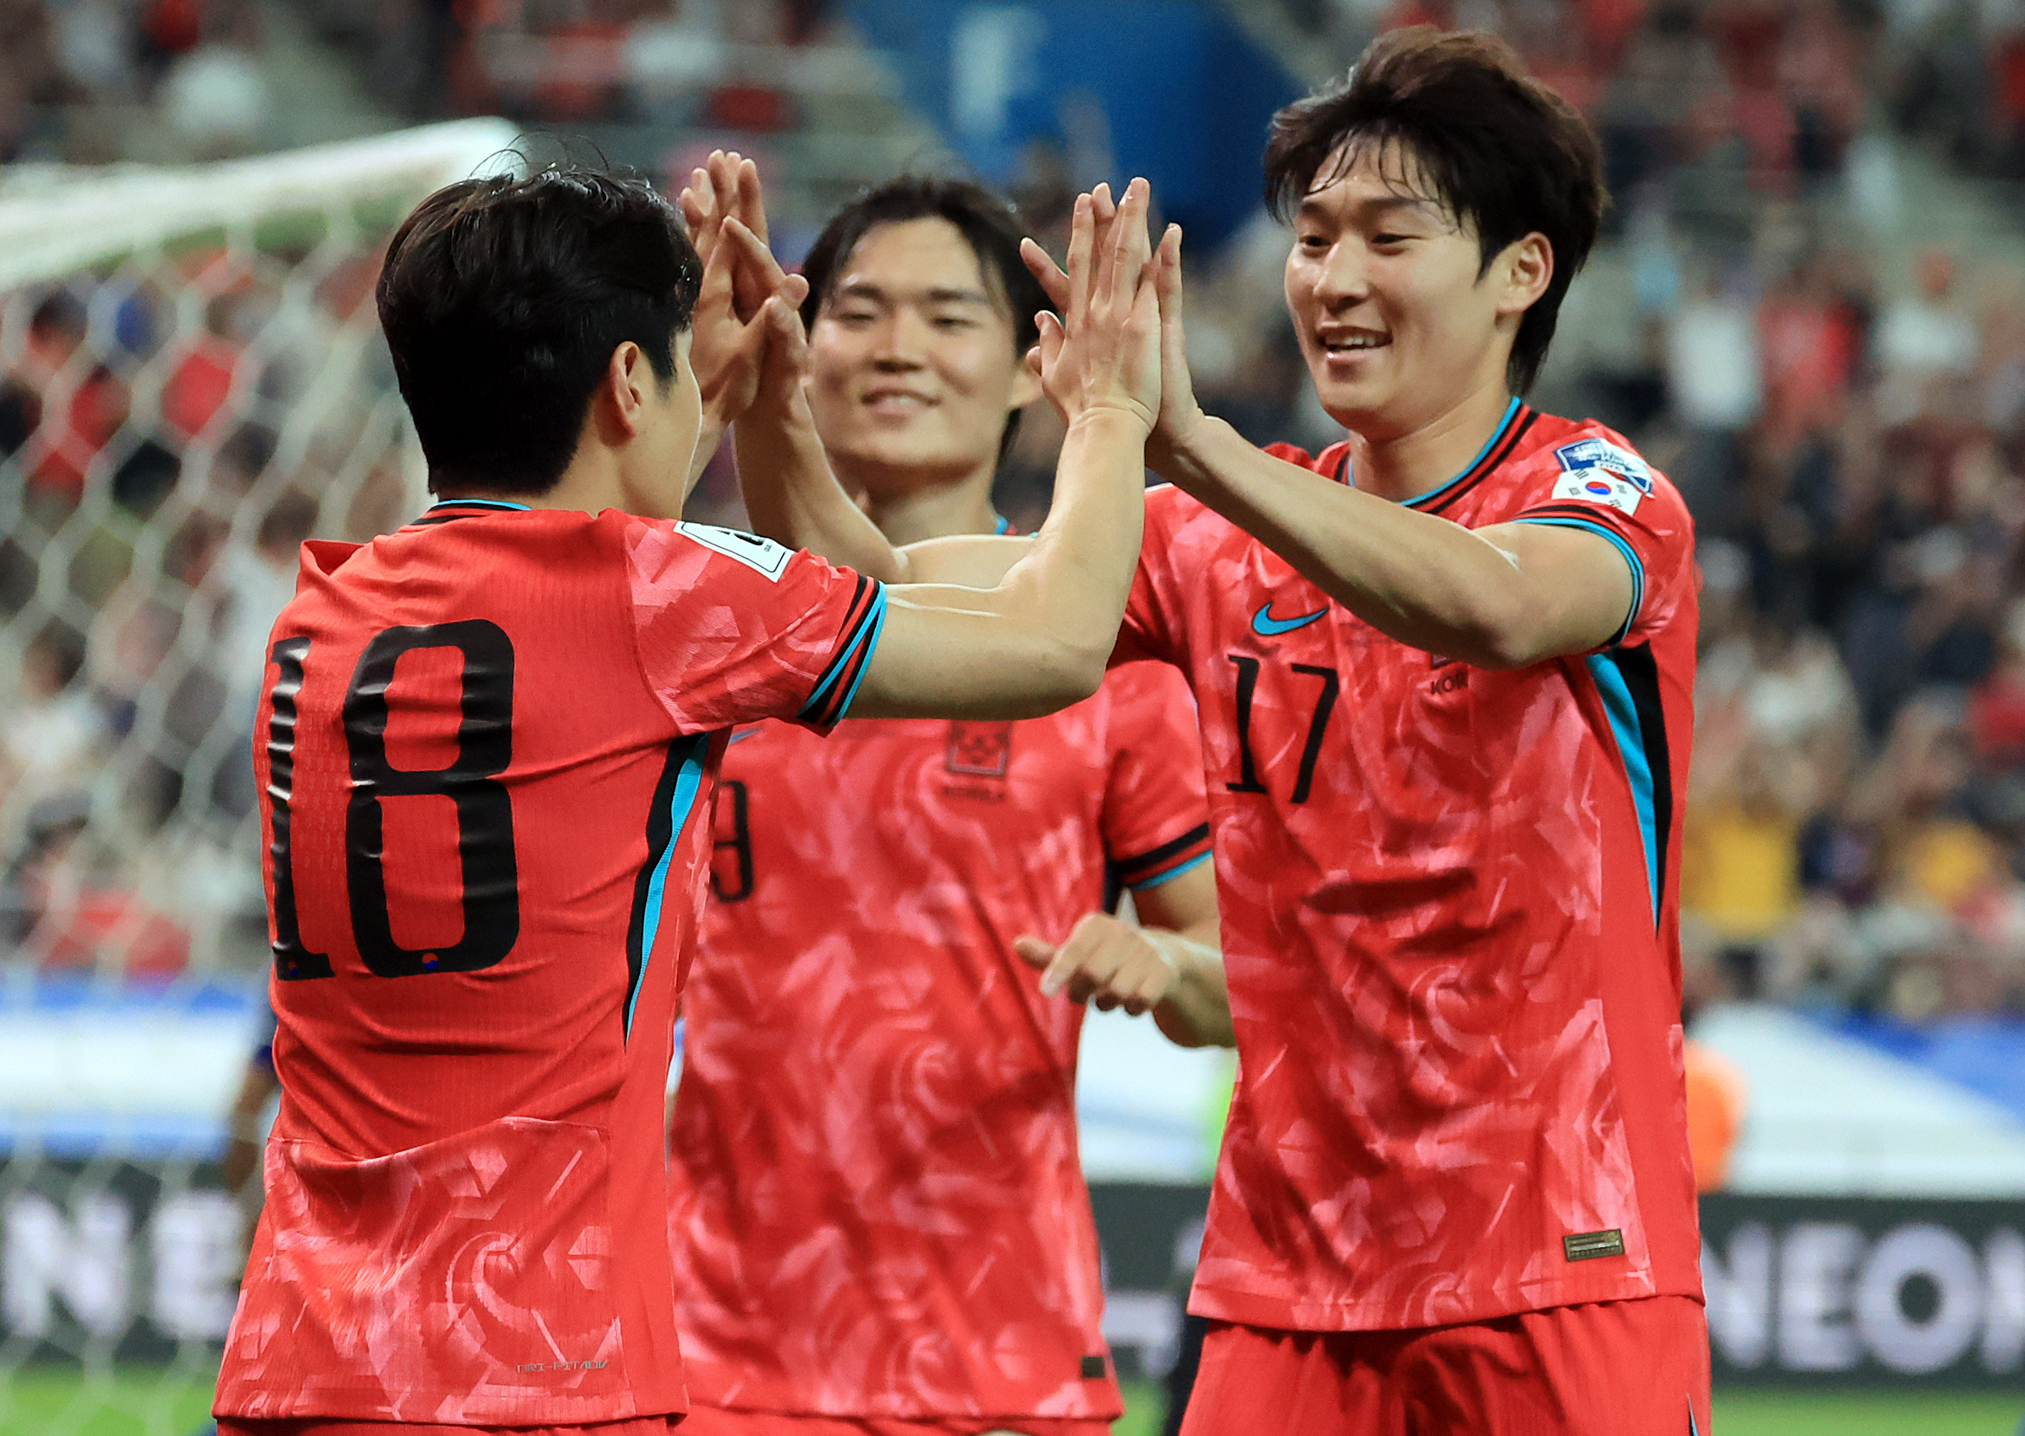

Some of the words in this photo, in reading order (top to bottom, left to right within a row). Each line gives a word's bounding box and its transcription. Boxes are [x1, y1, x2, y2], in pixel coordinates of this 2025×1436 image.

[267, 618, 520, 982] 18
[1226, 654, 1339, 804] 17
[710, 780, 753, 903] 9
